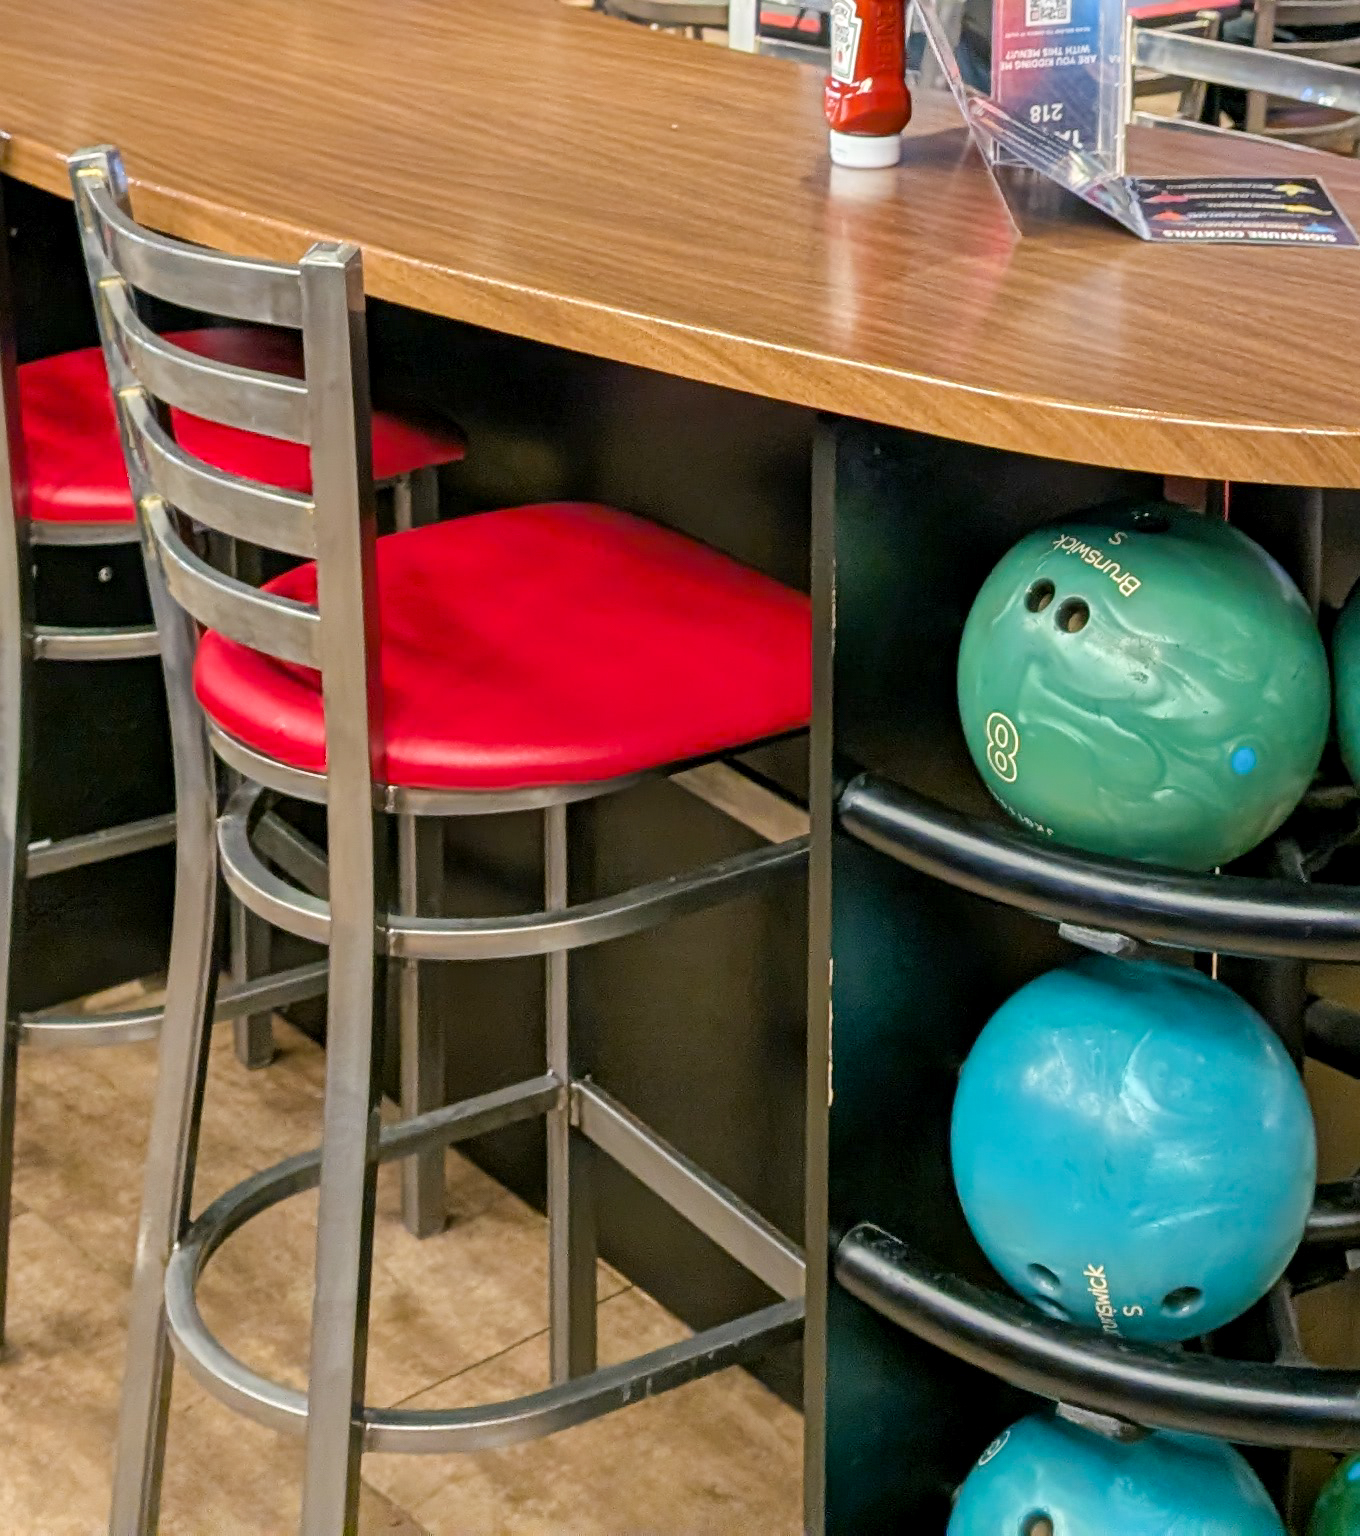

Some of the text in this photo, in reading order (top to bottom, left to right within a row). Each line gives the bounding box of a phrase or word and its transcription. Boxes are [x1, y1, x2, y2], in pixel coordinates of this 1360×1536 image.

[1042, 45, 1063, 56] THIS
[1055, 55, 1076, 67] YOU
[1075, 54, 1098, 65] ARE
[1029, 102, 1064, 124] 218
[1162, 228, 1338, 243] SIGNATURE COCKTAILS
[1052, 533, 1142, 597] Brunswick
[986, 712, 1019, 782] 8
[1083, 1263, 1124, 1339] runswick
[1122, 1305, 1144, 1317] S
